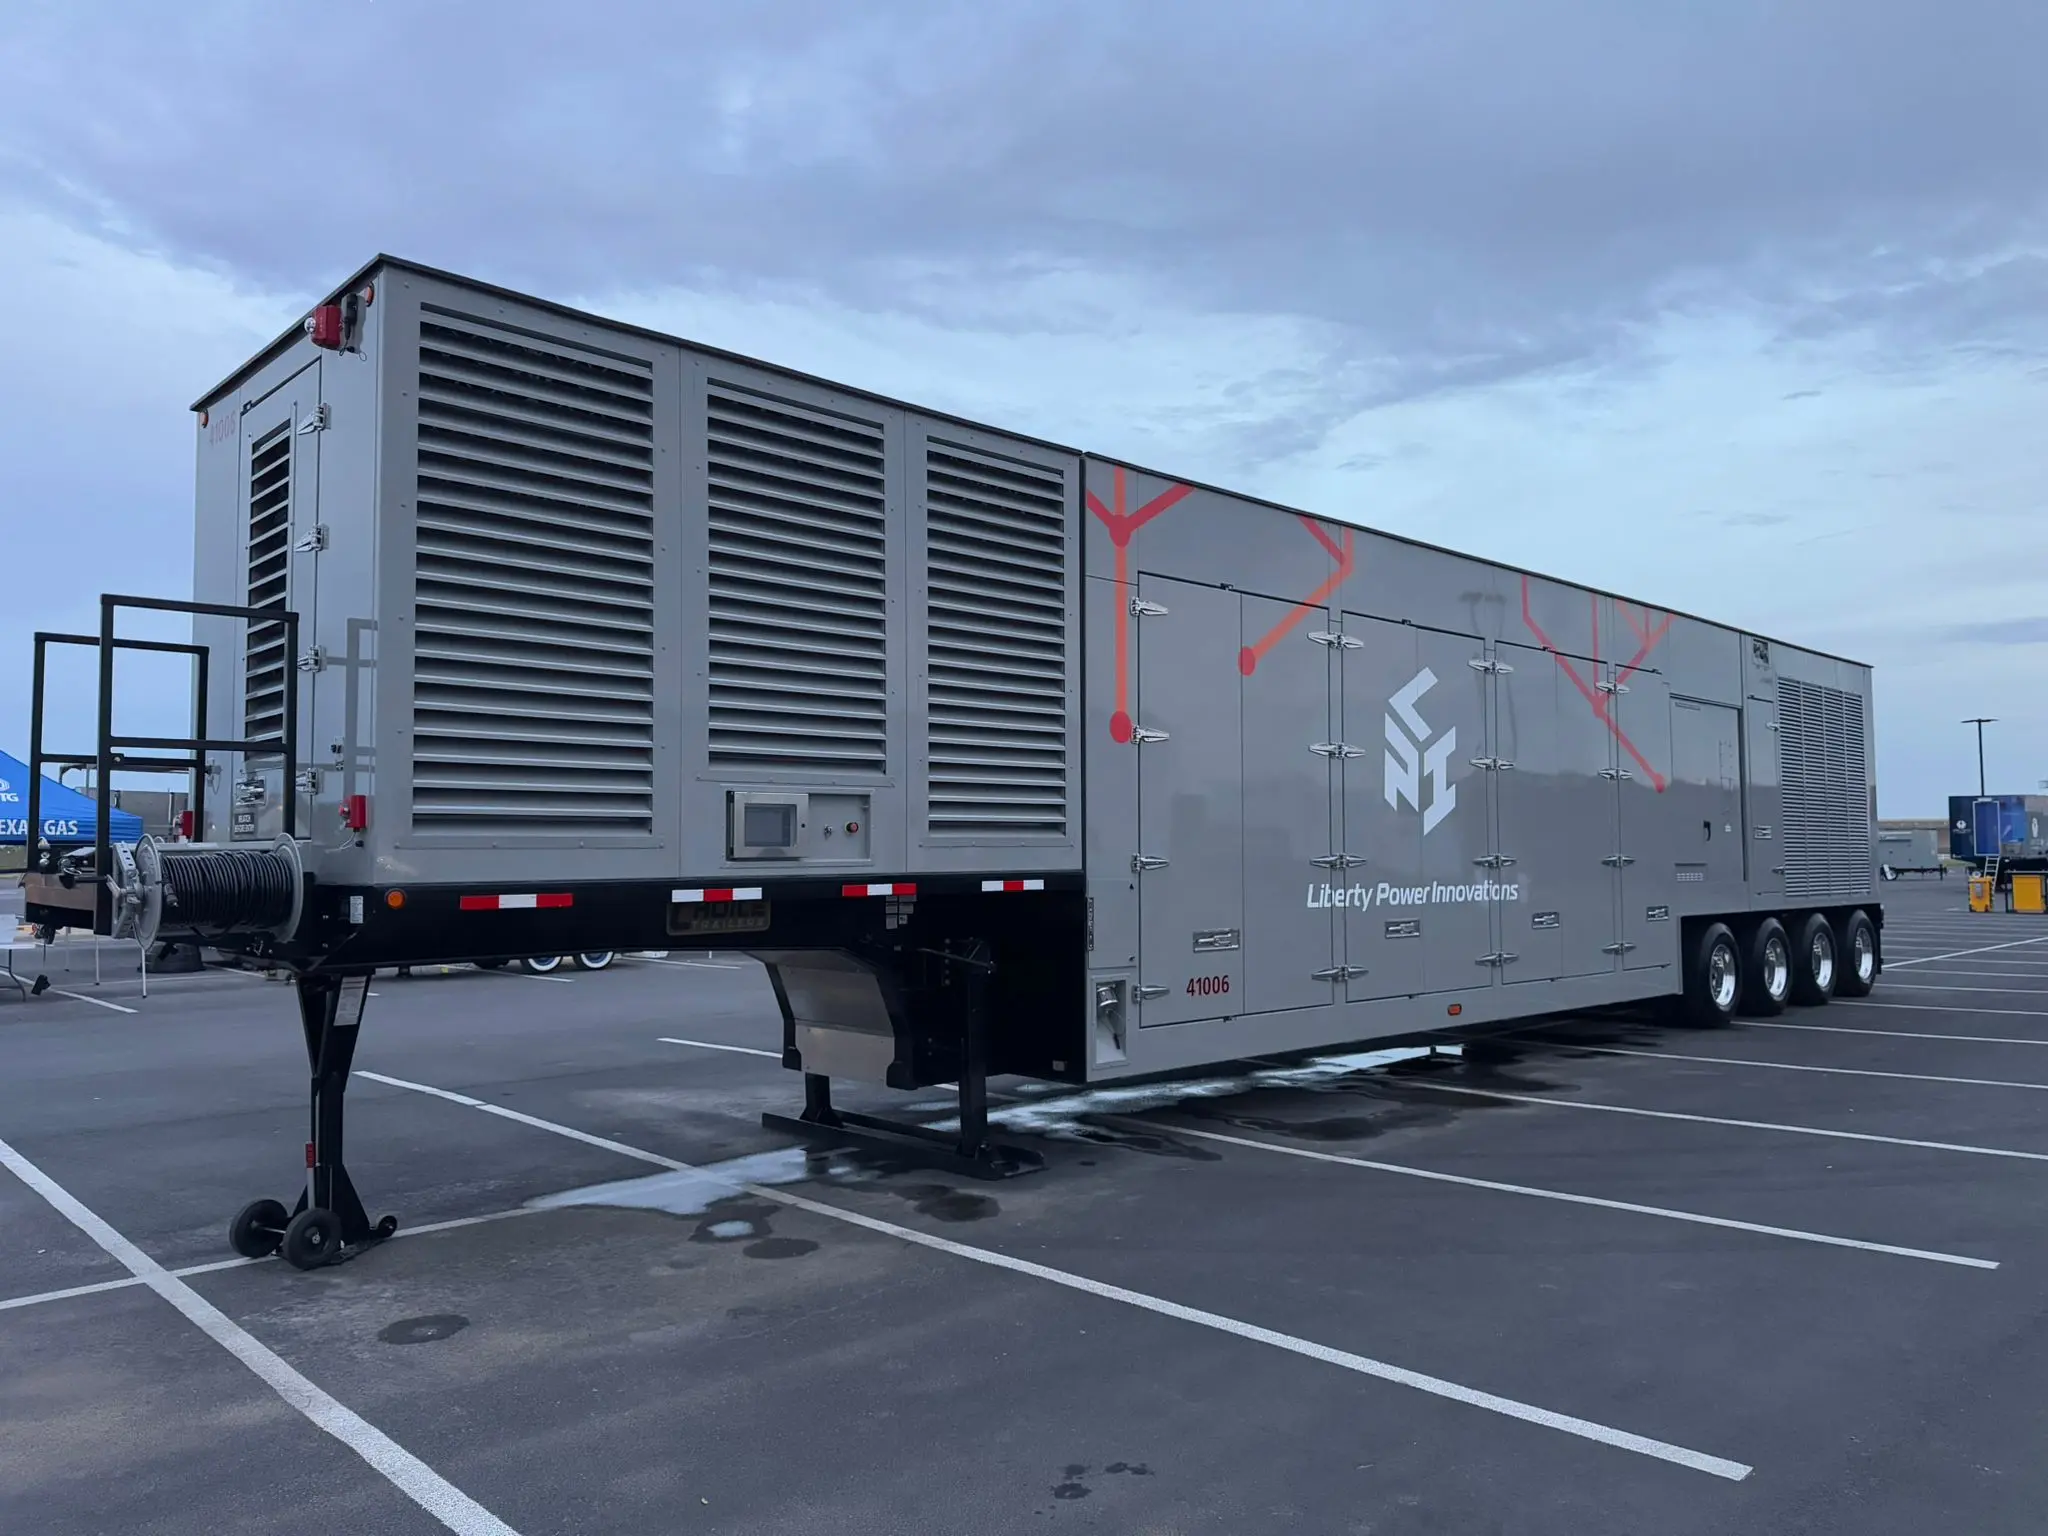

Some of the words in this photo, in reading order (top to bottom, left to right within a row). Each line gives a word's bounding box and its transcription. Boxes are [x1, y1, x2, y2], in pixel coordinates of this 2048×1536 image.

[0, 819, 28, 836] EXA
[44, 819, 78, 836] GAS
[1306, 883, 1373, 912] Liberty
[1376, 882, 1430, 906] Power
[1431, 880, 1518, 903] Innovations
[1186, 974, 1230, 997] 41006
